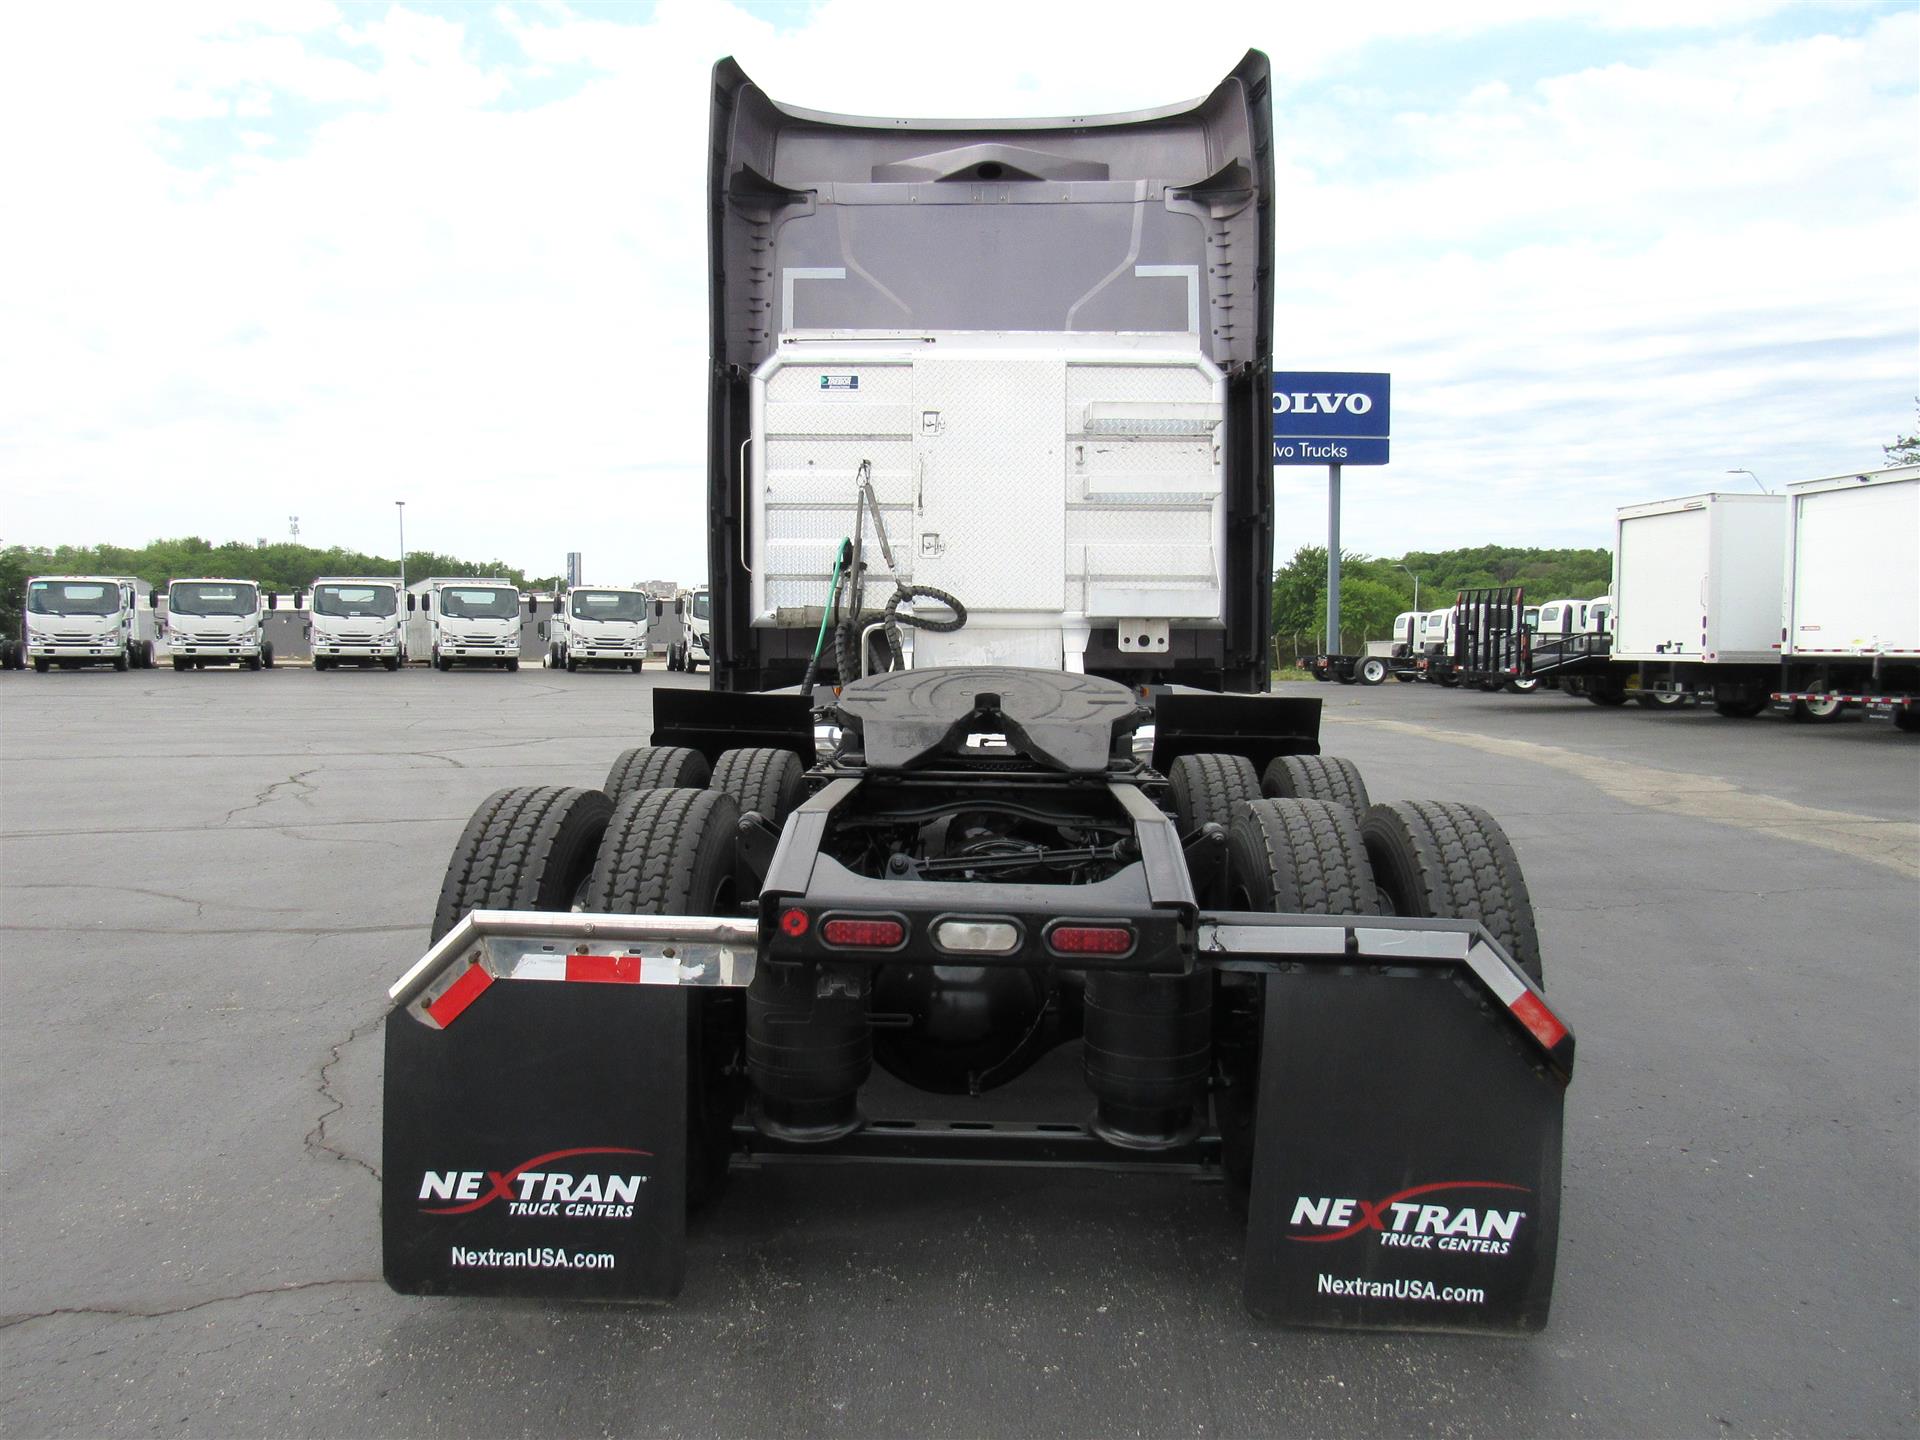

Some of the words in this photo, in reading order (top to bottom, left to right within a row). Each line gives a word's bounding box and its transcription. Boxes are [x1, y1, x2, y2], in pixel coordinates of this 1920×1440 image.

[1272, 392, 1372, 415] OLVO
[1273, 442, 1294, 458] lvo
[1298, 442, 1348, 458] Trucks
[418, 1170, 642, 1203] NEXTRAN
[508, 1202, 559, 1216] TRUCK
[565, 1203, 634, 1218] CENTERS
[1289, 1196, 1521, 1240] NEXTRAN
[1380, 1232, 1432, 1249] TRUCK
[1437, 1237, 1511, 1254] CENTERS
[451, 1246, 615, 1269] NextranUSA.com
[1317, 1273, 1484, 1303] NextranUSA.com
